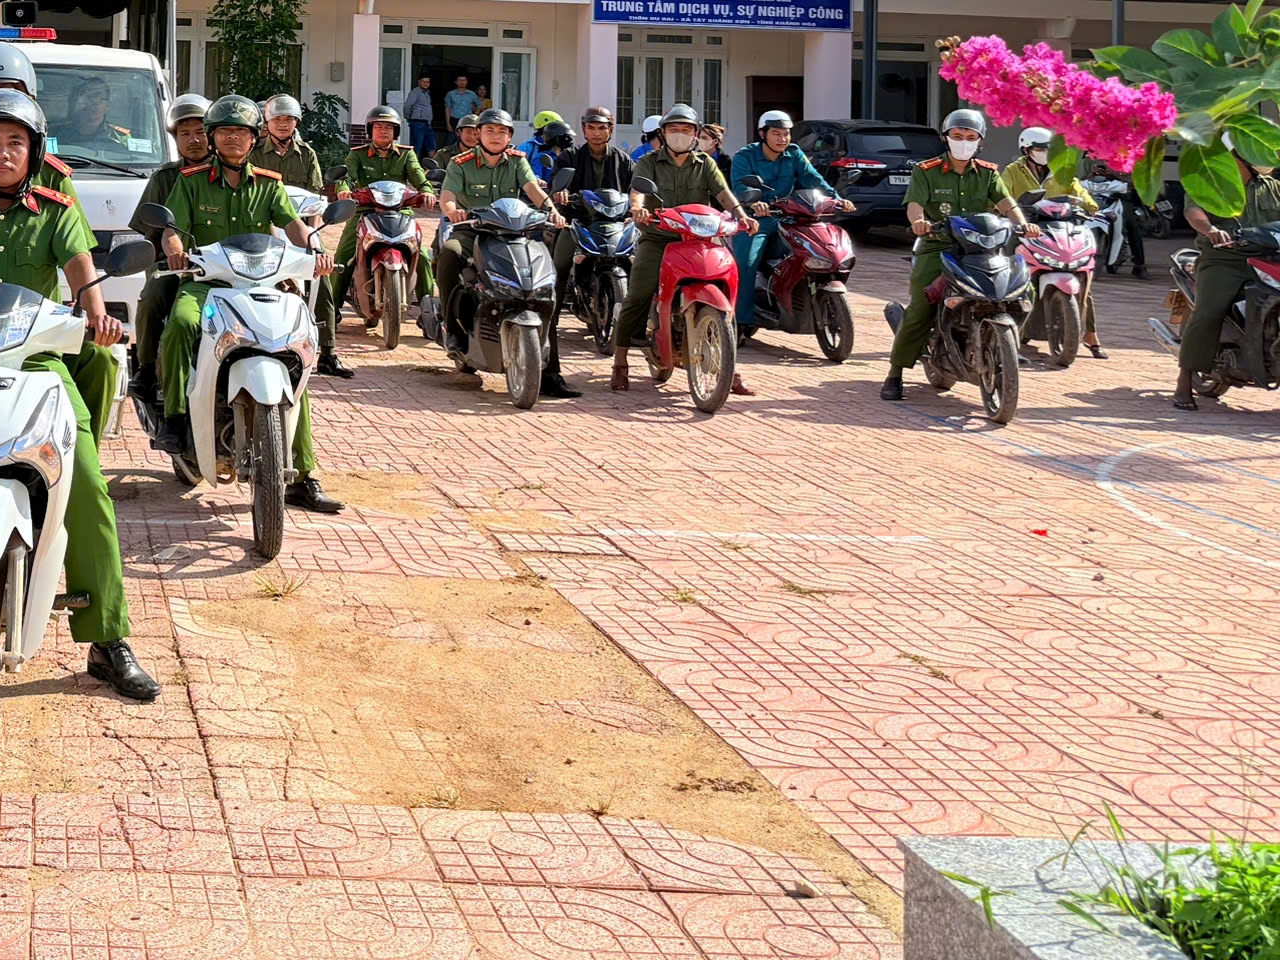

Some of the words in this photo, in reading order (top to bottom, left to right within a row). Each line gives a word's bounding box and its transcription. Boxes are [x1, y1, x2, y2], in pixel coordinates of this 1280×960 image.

[601, 0, 644, 12] TRUNG
[647, 0, 675, 14] TÂM
[679, 2, 709, 16] DỊCH
[713, 3, 734, 18] VỤ,
[737, 4, 756, 19] SỰ
[758, 5, 805, 20] NGHIỆP
[808, 6, 844, 20] CÔNG
